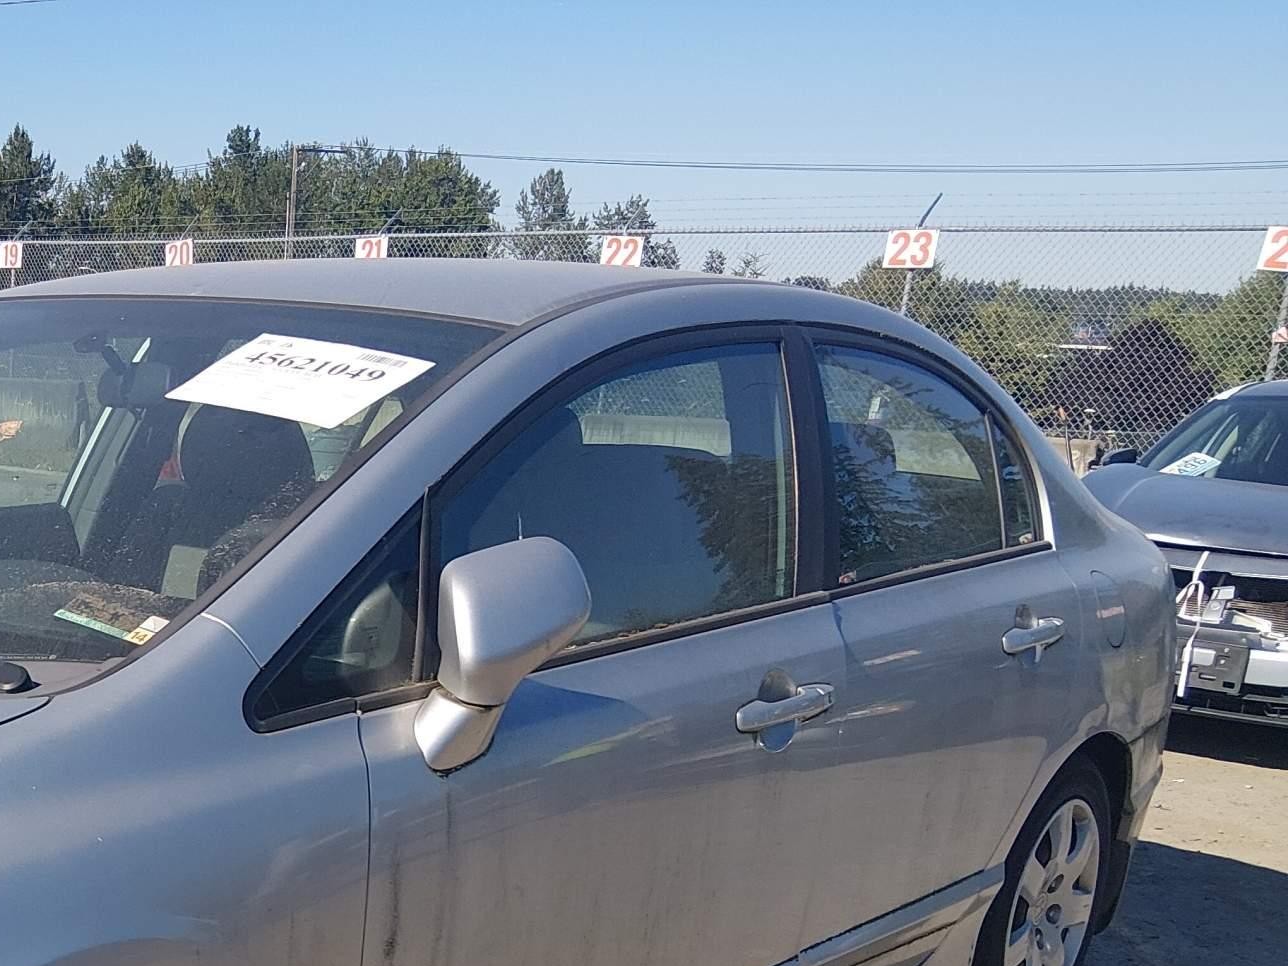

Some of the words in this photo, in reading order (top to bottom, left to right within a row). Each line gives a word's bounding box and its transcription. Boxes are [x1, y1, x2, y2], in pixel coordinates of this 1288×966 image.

[4, 244, 18, 266] 19
[168, 241, 190, 265] 20
[362, 239, 382, 258] 21
[606, 238, 639, 266] 22
[888, 231, 932, 266] 23
[244, 351, 387, 382] 45621049
[131, 631, 148, 642] 14
